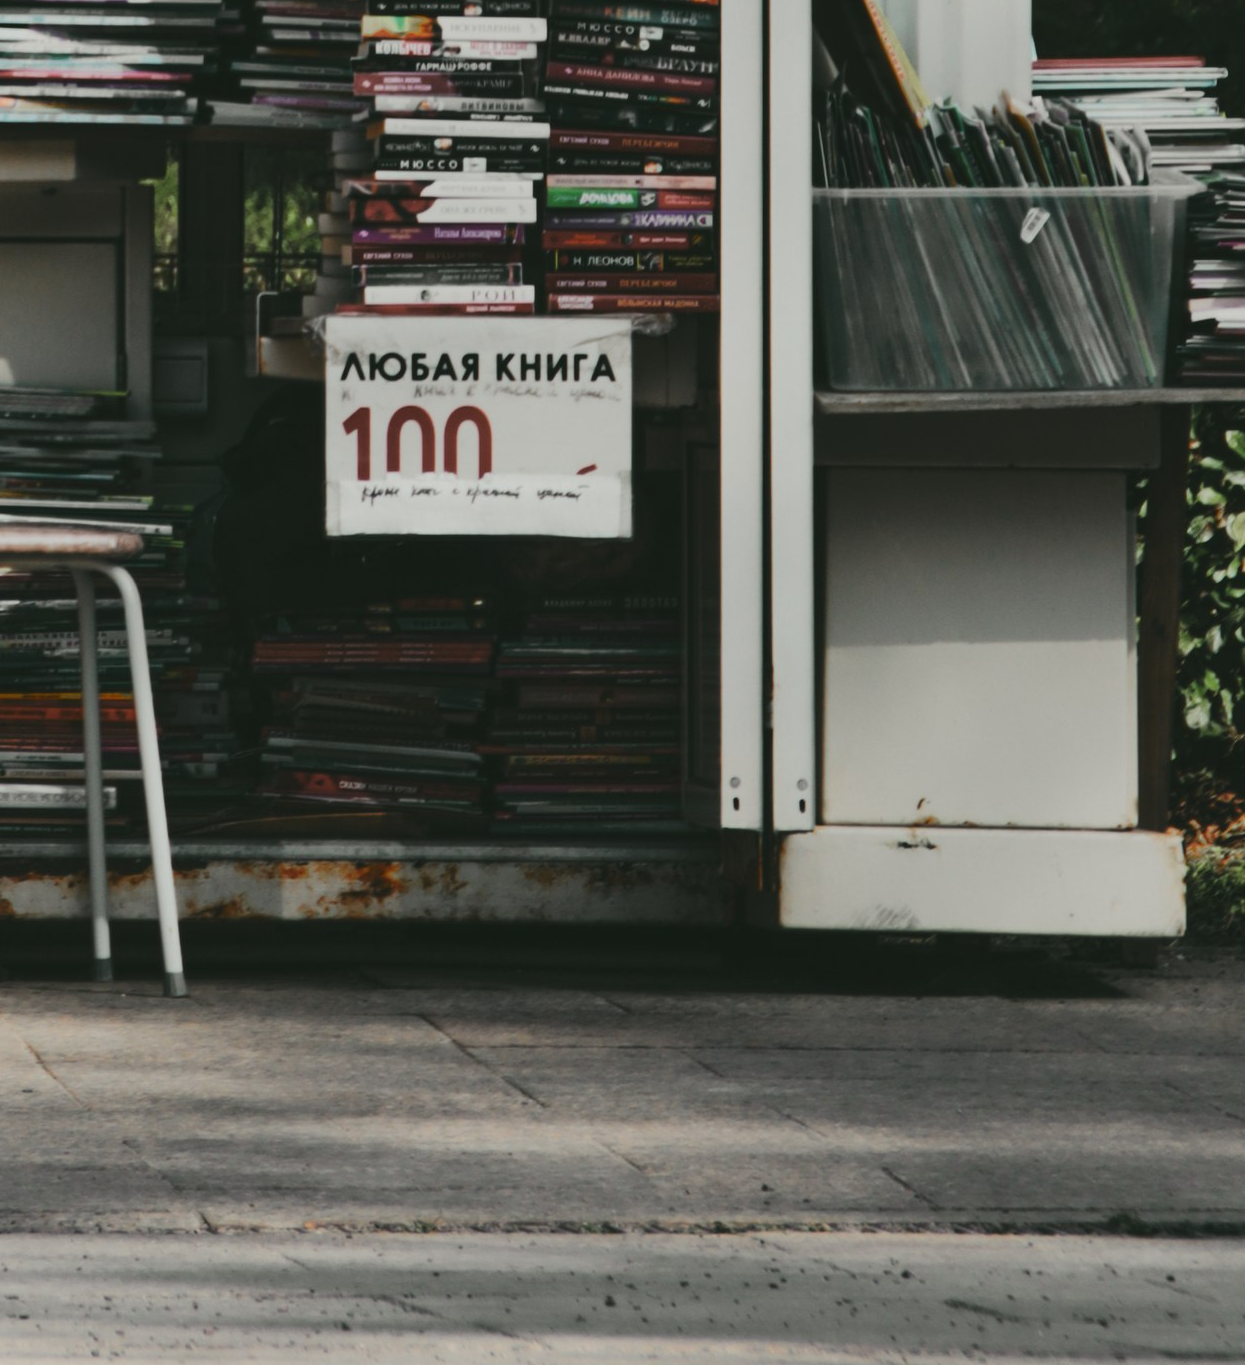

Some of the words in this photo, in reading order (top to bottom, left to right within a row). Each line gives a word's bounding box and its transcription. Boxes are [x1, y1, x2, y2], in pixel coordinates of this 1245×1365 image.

[577, 22, 635, 35] МЮССО
[375, 41, 432, 55] КОЛЫЧЕВ
[657, 57, 714, 74] БРАУН
[576, 68, 603, 78] АННА
[604, 70, 656, 83] ДАНИЛОВА
[460, 102, 525, 112] ЛИТВИНОВЫ
[400, 159, 458, 169] МЮССО
[579, 191, 635, 205] ДОНЦОВА
[587, 255, 635, 267] ЛЕОНОВ
[471, 290, 516, 301] РОЙ
[340, 352, 480, 381] ЛЮБАЯ
[496, 353, 617, 382] КНИГА
[342, 405, 493, 481] 100
